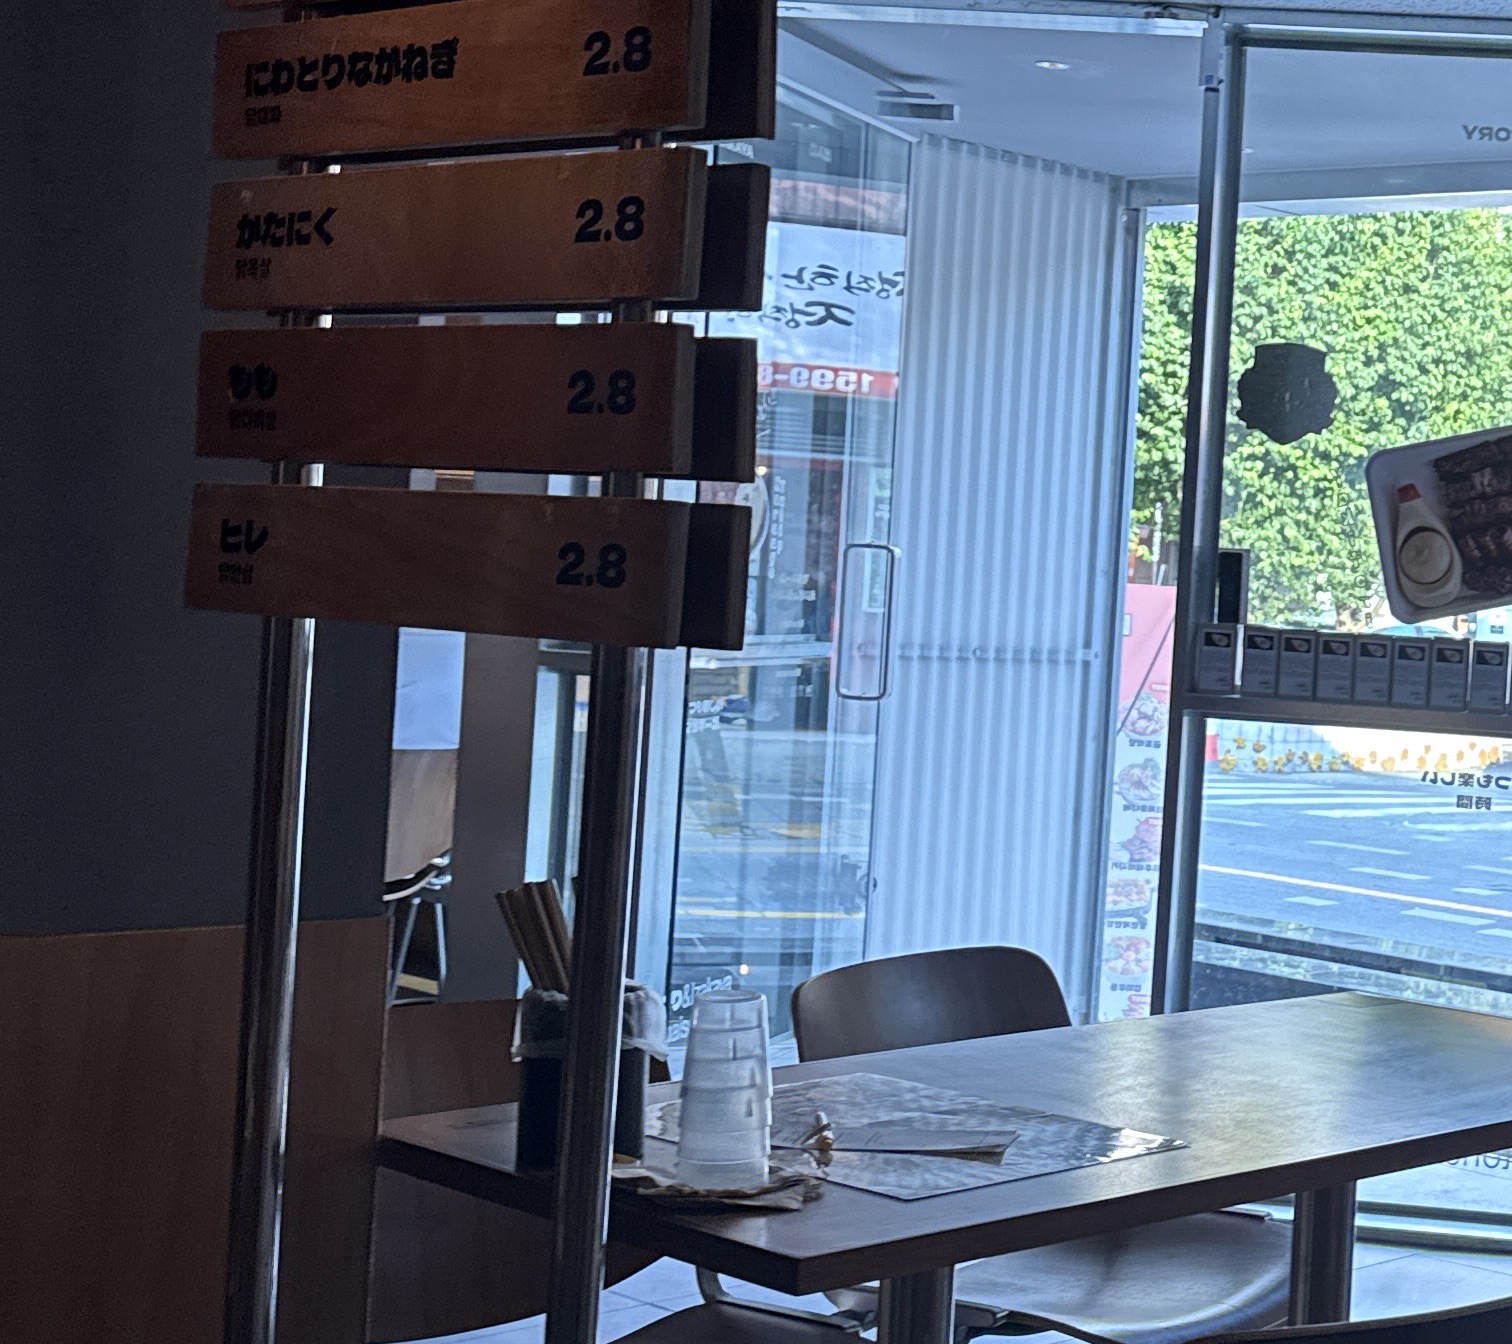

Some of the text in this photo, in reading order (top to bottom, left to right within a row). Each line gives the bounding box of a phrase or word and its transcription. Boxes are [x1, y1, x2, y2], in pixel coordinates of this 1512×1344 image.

[583, 26, 652, 76] 2.8
[575, 196, 645, 242] 2.8
[567, 370, 637, 415] 2.8
[556, 543, 627, 588] 2.8
